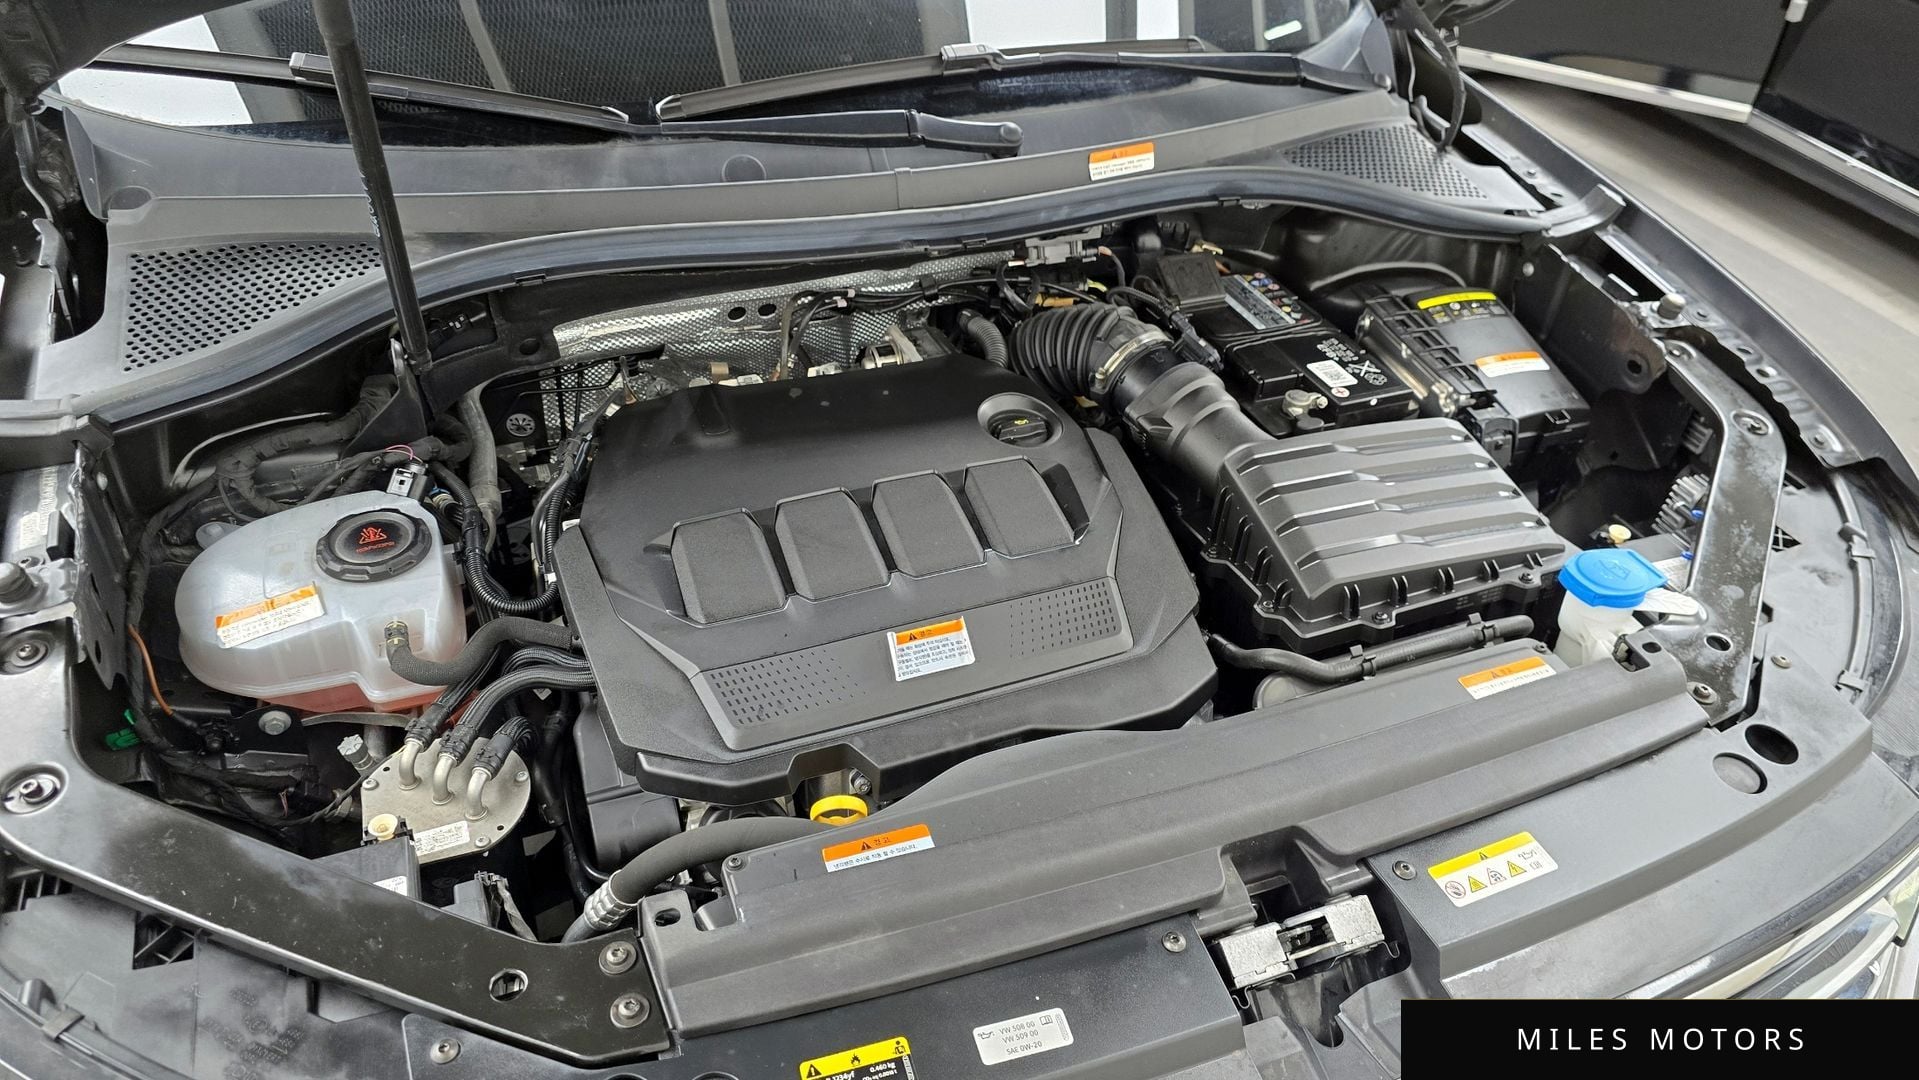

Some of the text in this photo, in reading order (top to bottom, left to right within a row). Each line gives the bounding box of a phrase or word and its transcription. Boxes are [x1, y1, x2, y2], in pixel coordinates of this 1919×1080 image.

[999, 1020, 1036, 1035] VW 508 00
[1002, 1029, 1039, 1044] VW 509 00
[1006, 1040, 1043, 1056] SAE 0W-20
